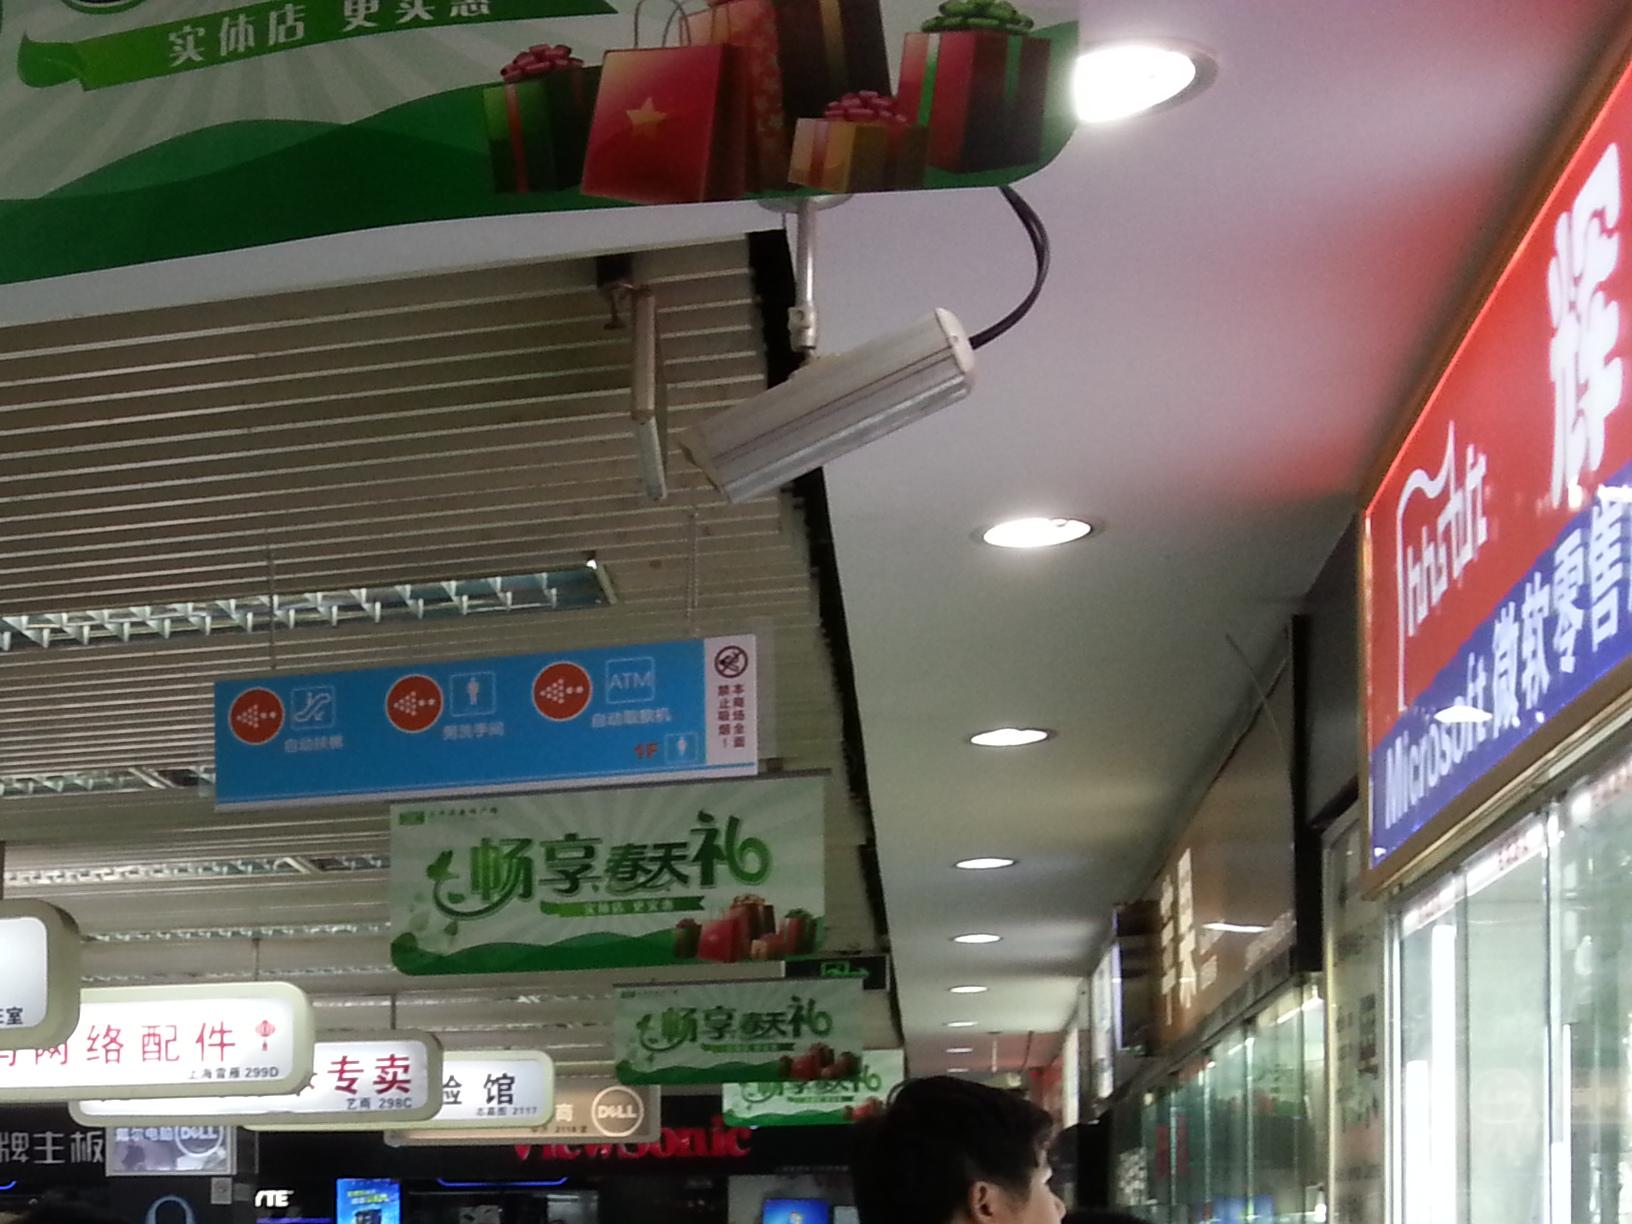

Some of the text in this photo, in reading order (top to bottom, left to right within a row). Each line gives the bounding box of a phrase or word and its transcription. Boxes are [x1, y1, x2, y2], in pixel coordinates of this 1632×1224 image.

[168, 3, 305, 66] 实体店
[608, 671, 652, 690] ATM
[1385, 484, 1632, 830] Microsoft 微软零售
[430, 810, 771, 916] 畅享春天礼
[326, 1053, 412, 1096] 专卖
[597, 1105, 638, 1119] DELL
